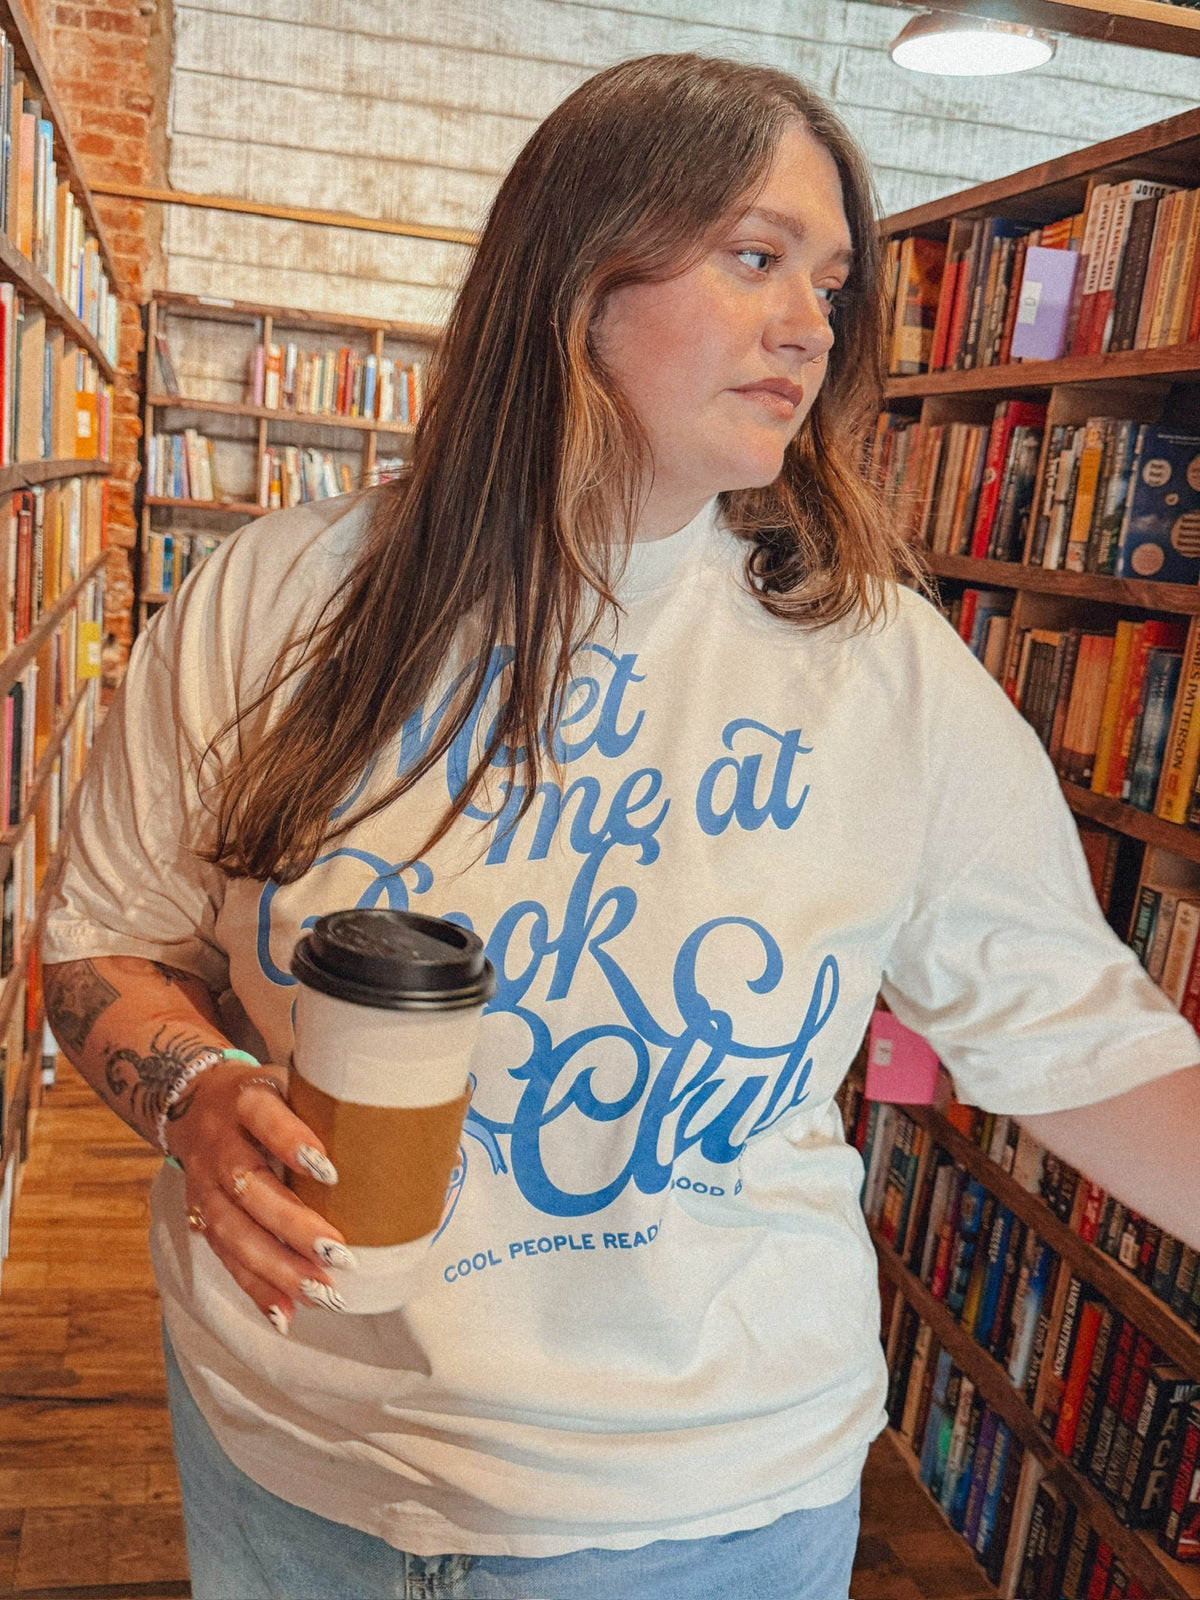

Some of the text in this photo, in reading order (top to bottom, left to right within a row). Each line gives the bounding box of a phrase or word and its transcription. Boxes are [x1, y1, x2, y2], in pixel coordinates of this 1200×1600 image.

[1136, 184, 1166, 198] JOYCE
[1172, 682, 1198, 770] PATTERSON
[484, 718, 814, 867] me at
[257, 838, 690, 1050] ok
[506, 916, 840, 1218] Club
[443, 1249, 502, 1283] COOL
[509, 1233, 596, 1260] PEOPLE
[602, 1224, 659, 1250] READ
[670, 1176, 725, 1197] OOD
